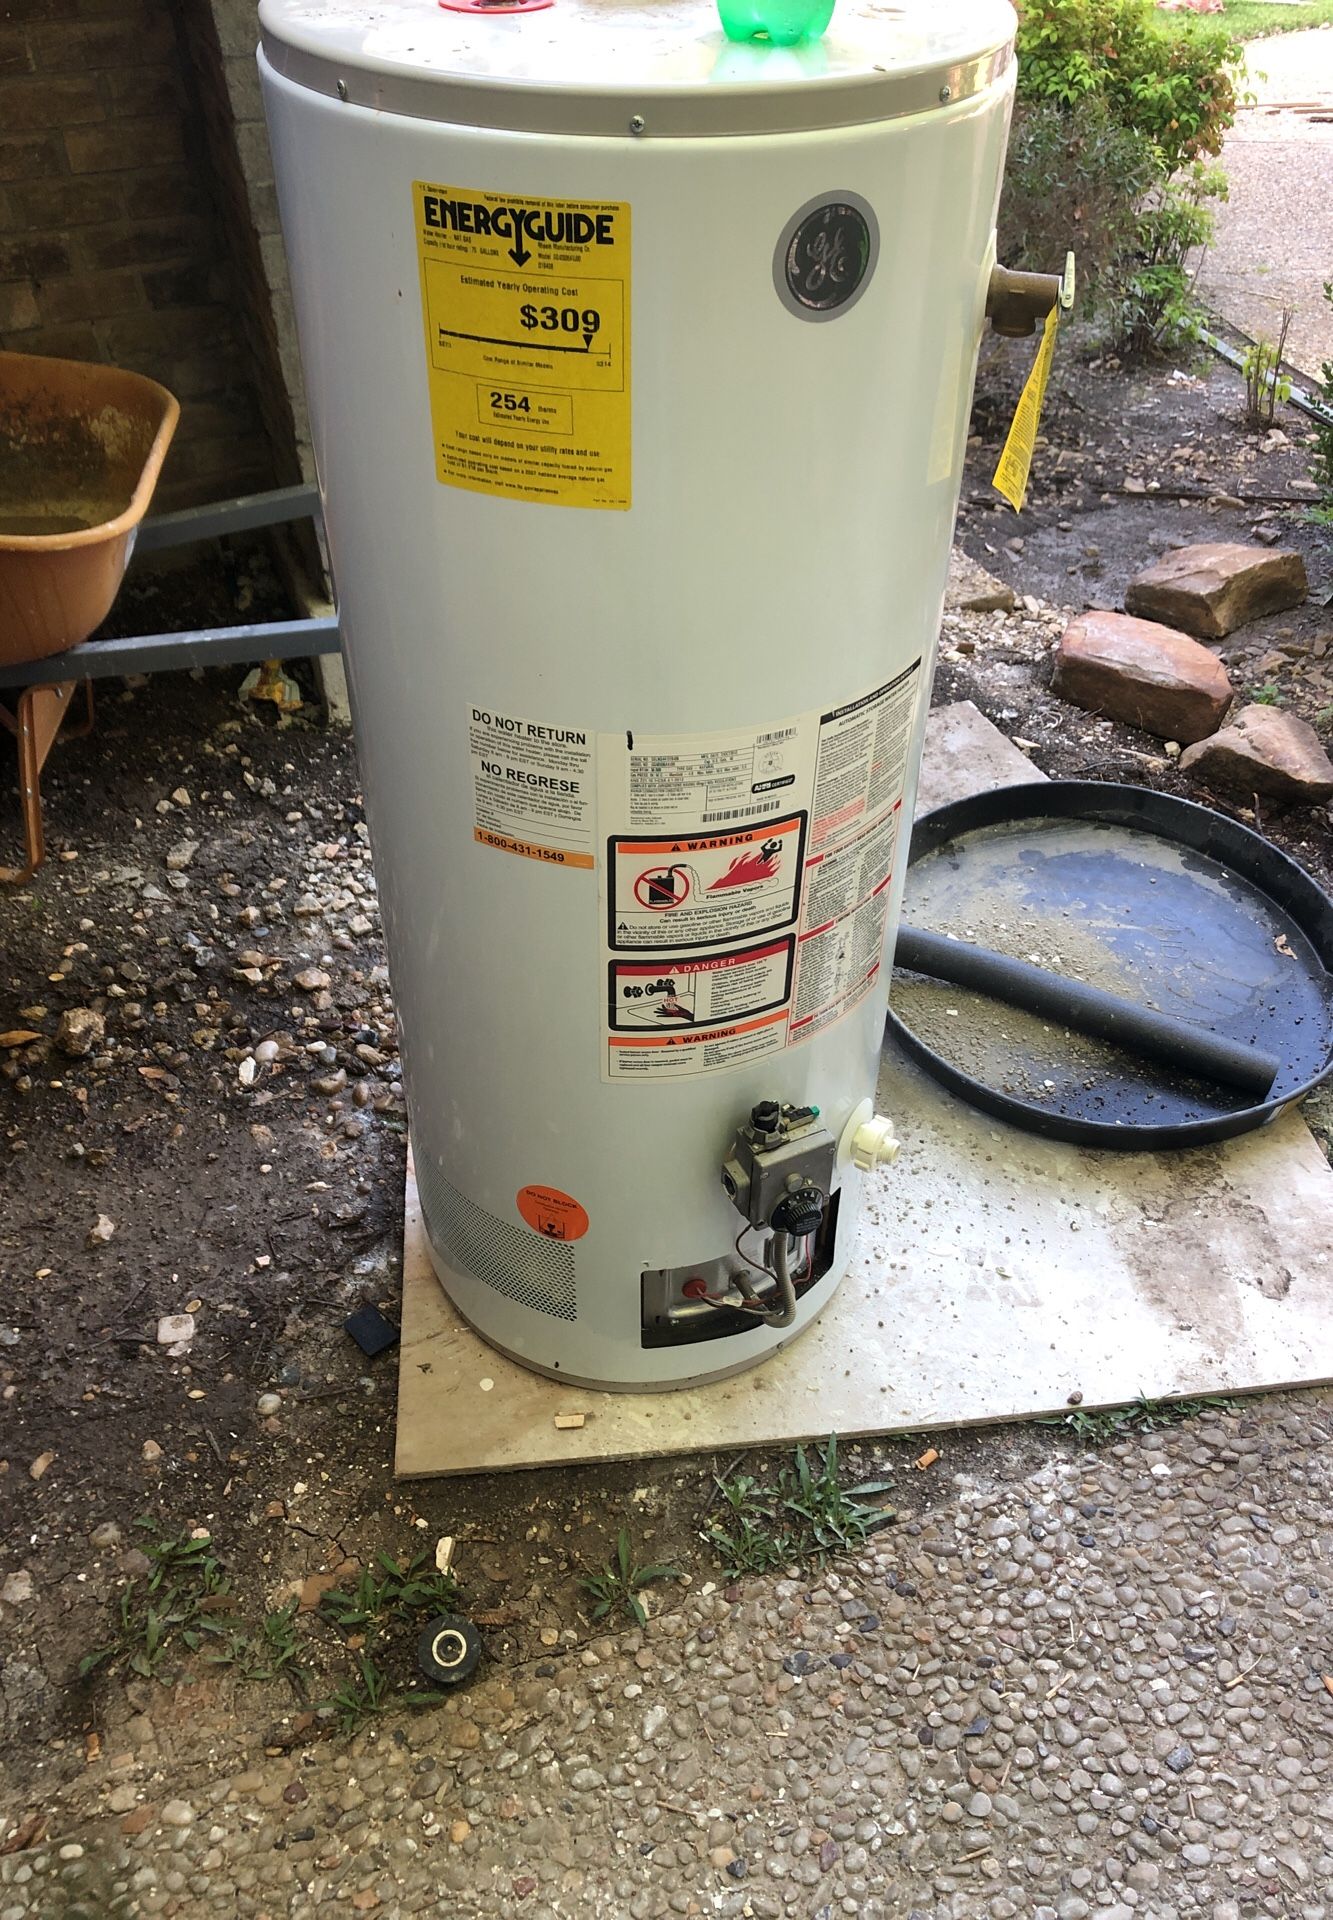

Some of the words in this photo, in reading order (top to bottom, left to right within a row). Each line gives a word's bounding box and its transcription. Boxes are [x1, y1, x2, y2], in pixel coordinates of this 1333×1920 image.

[424, 196, 614, 248] ENERGYGUIDE
[480, 247, 500, 256] GALLONS
[460, 275, 494, 288] Estimated
[497, 281, 520, 293] Yearly
[523, 284, 558, 296] Operating
[562, 288, 578, 296] Cost
[520, 304, 600, 333] $309
[490, 392, 530, 413] 254
[456, 430, 467, 439] Your
[494, 438, 514, 448] depend
[540, 446, 557, 455] utility
[472, 709, 491, 725] DO
[495, 716, 522, 733] NOT
[528, 724, 586, 745] RETURN
[481, 760, 501, 776] NO
[506, 768, 580, 793] REGRESE
[478, 831, 564, 862] 1-800-431-1549
[688, 834, 753, 850] WARNING
[706, 890, 740, 899] Flammable
[694, 906, 727, 915] EXPLOSION
[729, 901, 752, 909] HAZARD
[684, 958, 736, 972] DANGER
[682, 1028, 736, 1043] WARNING
[553, 1199, 577, 1208] BLOCK
